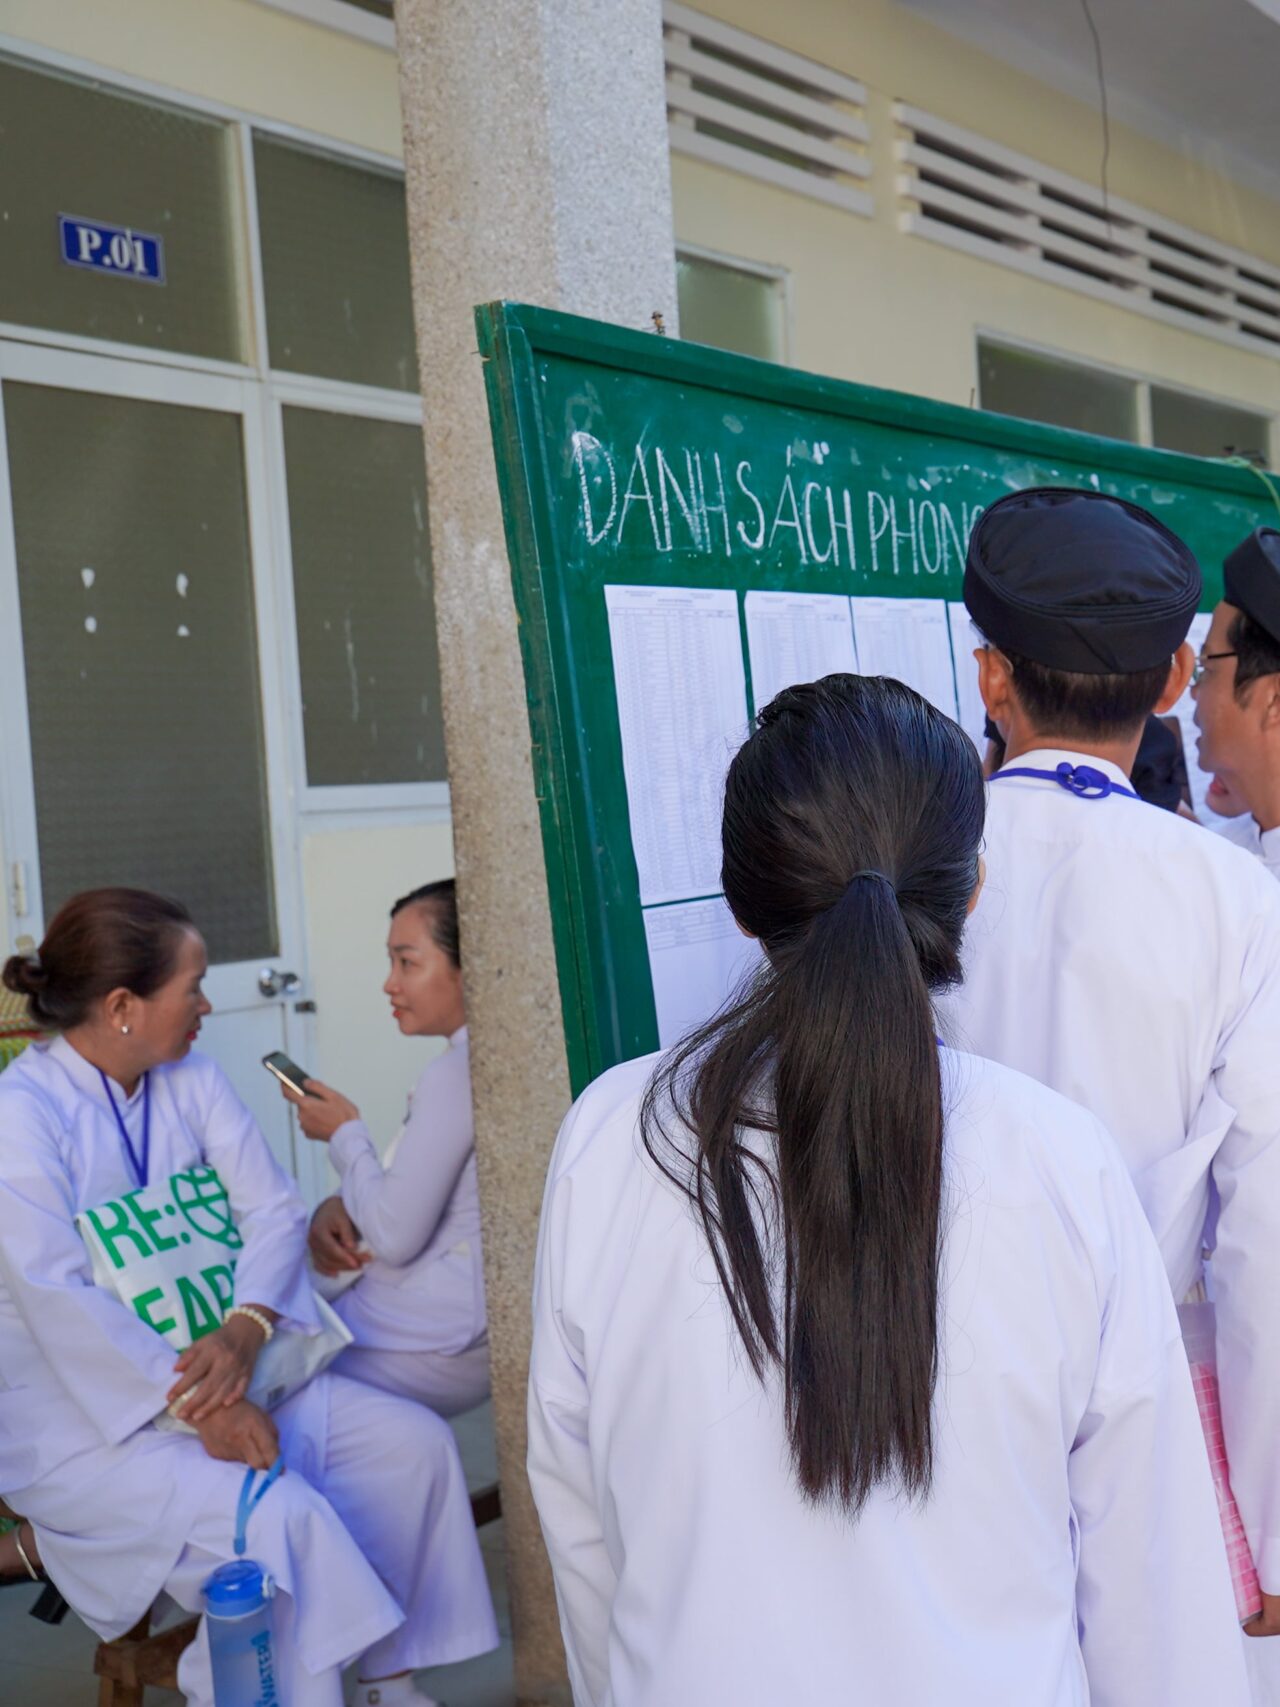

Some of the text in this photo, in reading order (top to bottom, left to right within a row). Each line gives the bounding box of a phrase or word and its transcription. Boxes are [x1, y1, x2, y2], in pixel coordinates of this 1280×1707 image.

[76, 226, 149, 274] P.01
[571, 431, 732, 557] DANH
[736, 444, 856, 571] SÁCH
